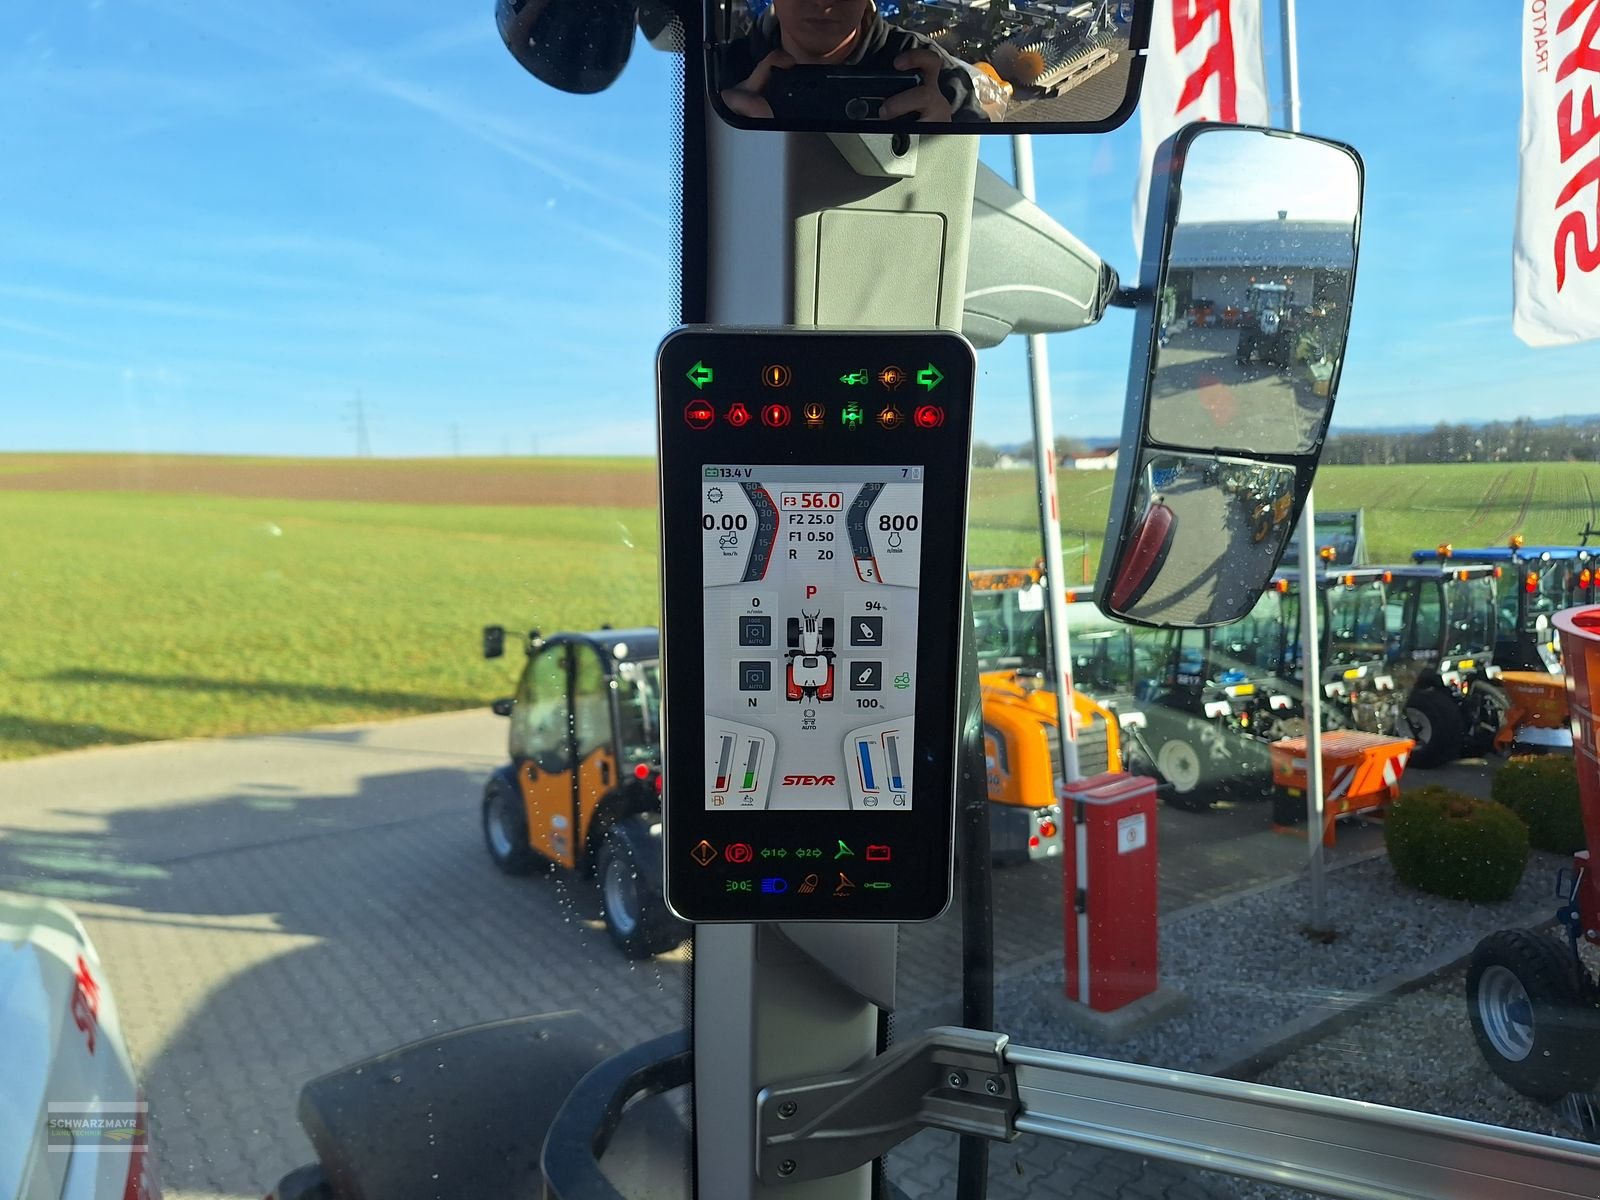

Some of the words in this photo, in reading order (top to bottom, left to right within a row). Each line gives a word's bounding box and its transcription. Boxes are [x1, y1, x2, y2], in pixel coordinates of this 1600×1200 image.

[720, 468, 741, 478] 13.4
[744, 468, 752, 478] V
[901, 468, 908, 478] 7
[868, 483, 880, 491] 30
[783, 497, 797, 506] F3
[801, 493, 840, 508] 56.0
[858, 500, 869, 508] 20
[703, 514, 747, 530] 0.00
[789, 515, 804, 524] F2
[807, 515, 834, 525] 25.0
[879, 515, 919, 531] 800
[854, 522, 863, 531] 15
[789, 532, 802, 541] F1
[807, 532, 834, 542] 0.50
[789, 550, 797, 560] R
[817, 549, 834, 560] 20
[806, 586, 817, 599] P
[752, 597, 760, 607] 0
[865, 601, 881, 611] 94
[748, 698, 757, 707] N
[856, 699, 878, 708] 100
[782, 776, 836, 786] STEYR
